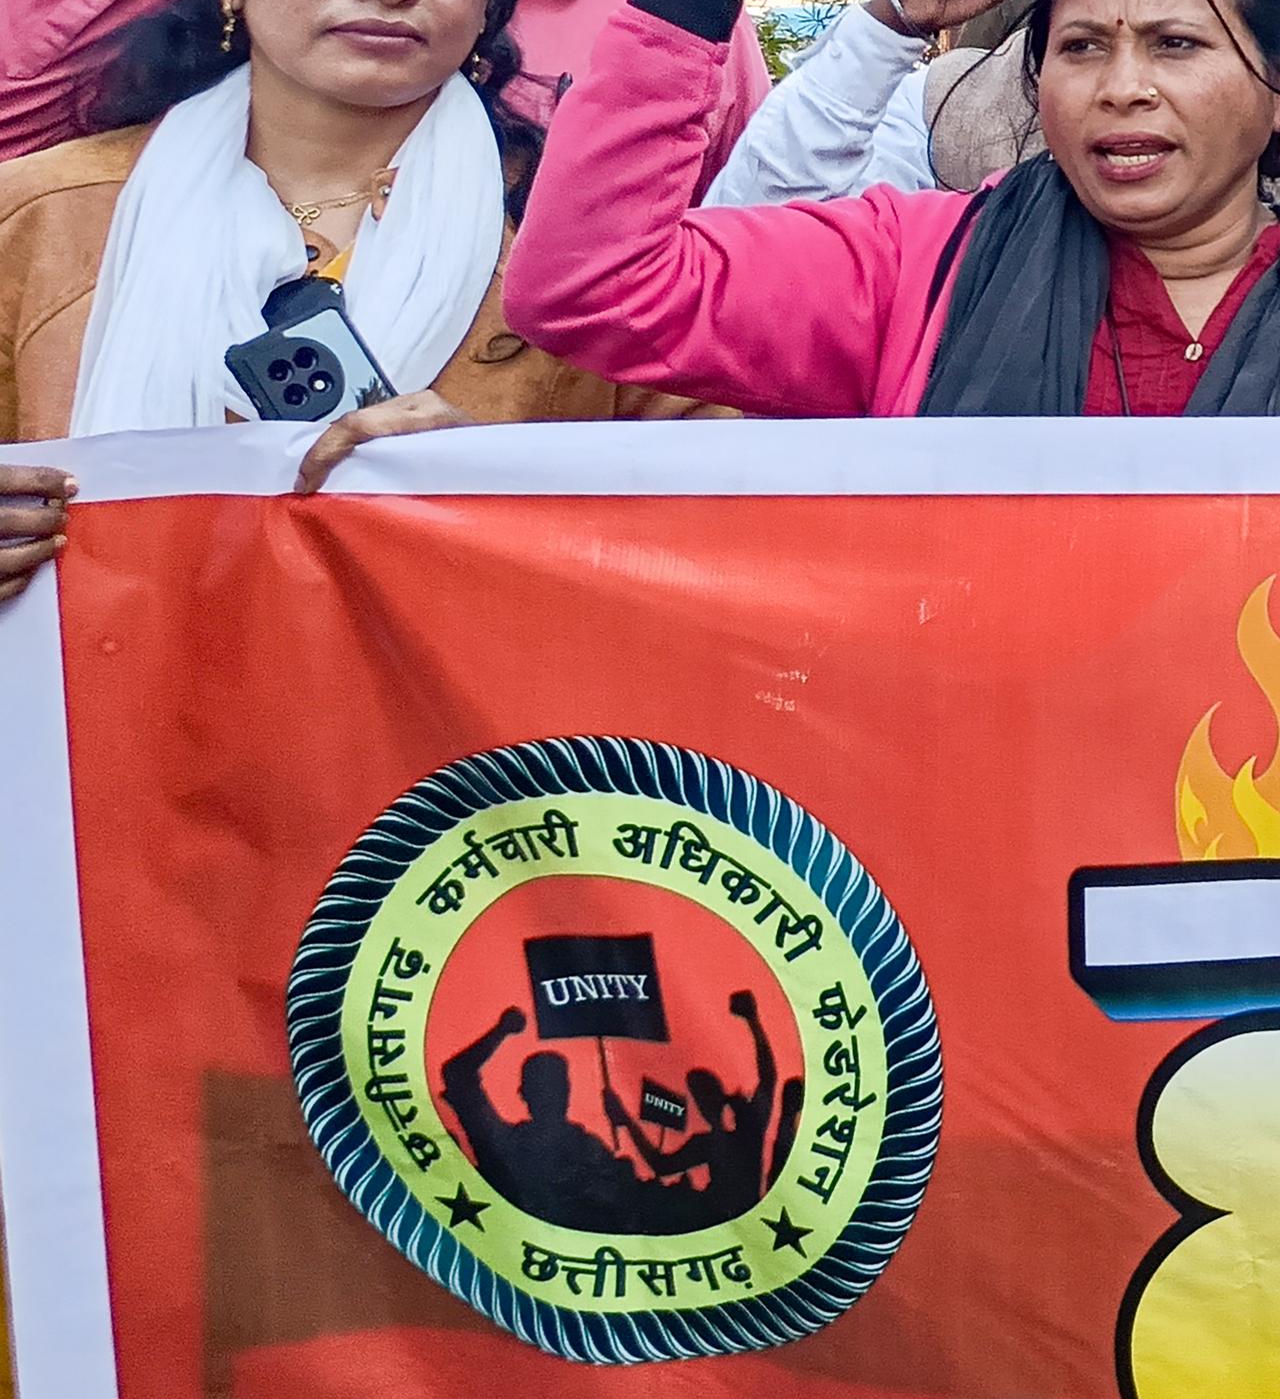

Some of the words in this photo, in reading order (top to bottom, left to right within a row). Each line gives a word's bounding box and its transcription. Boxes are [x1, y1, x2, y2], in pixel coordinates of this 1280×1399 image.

[364, 936, 441, 1173] छत्तीसगढ़
[415, 809, 579, 915] कर्मचारी
[612, 820, 824, 963] अधिकारी
[796, 981, 878, 1205] फेडरेशन
[540, 974, 650, 1006] UNITY
[644, 1093, 686, 1117] UNITY
[521, 1239, 754, 1298] छत्तीसगढ़
